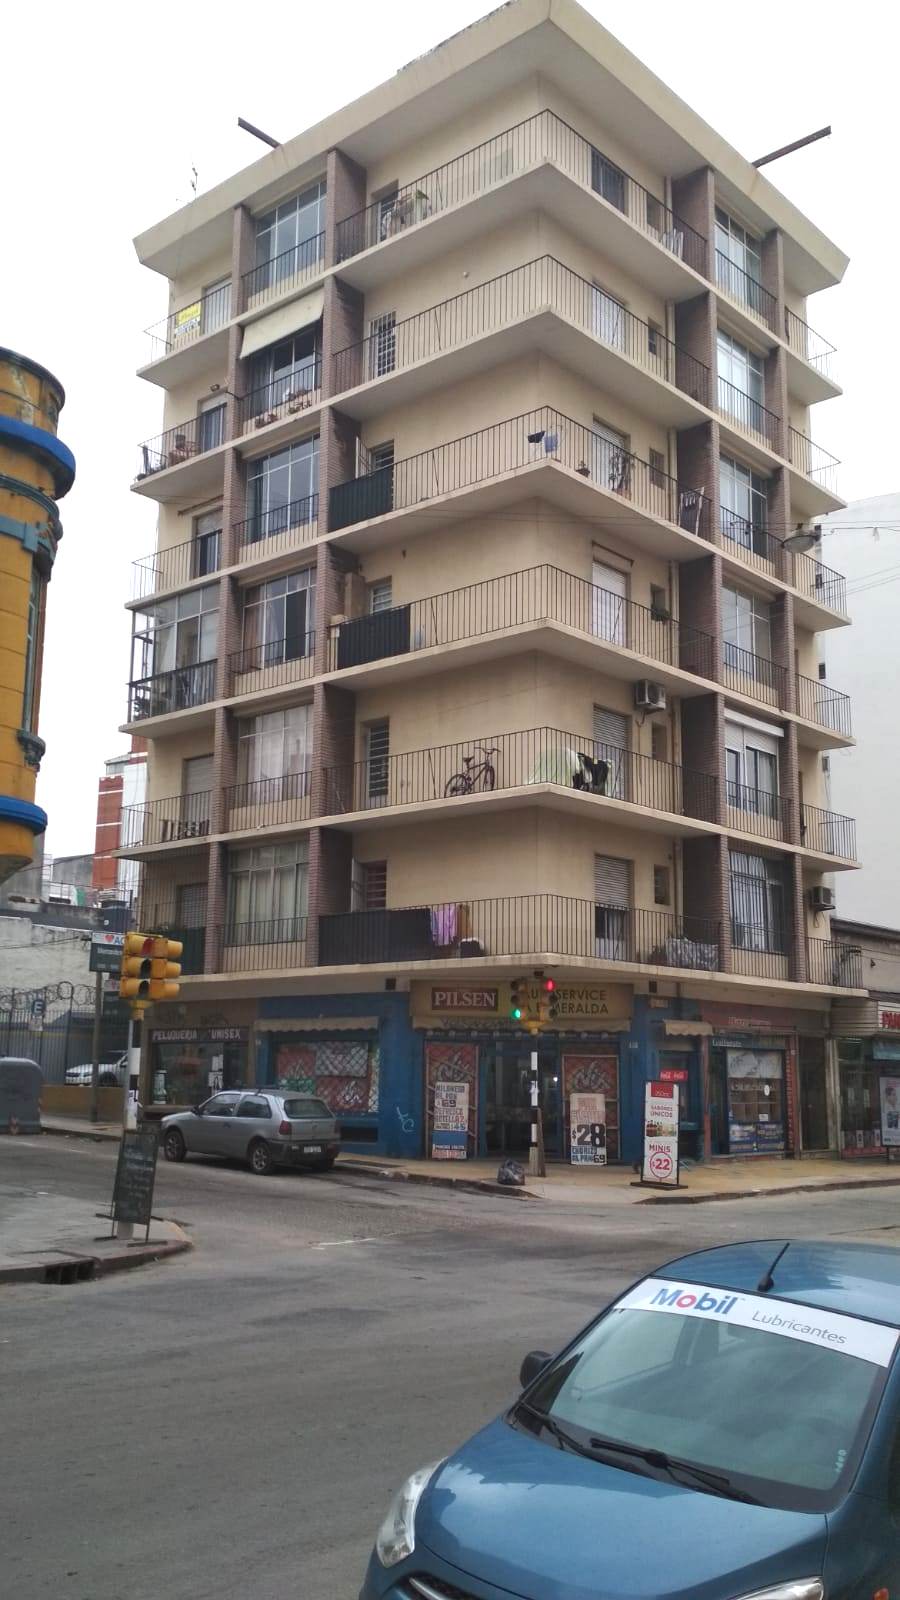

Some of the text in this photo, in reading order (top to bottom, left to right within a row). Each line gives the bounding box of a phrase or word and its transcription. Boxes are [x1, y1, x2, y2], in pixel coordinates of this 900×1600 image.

[434, 991, 497, 1007] PILSEN
[211, 1028, 241, 1040] UNISEX
[649, 1144, 671, 1153] MINIS
[650, 1287, 848, 1345] Mobil Lubricantes
